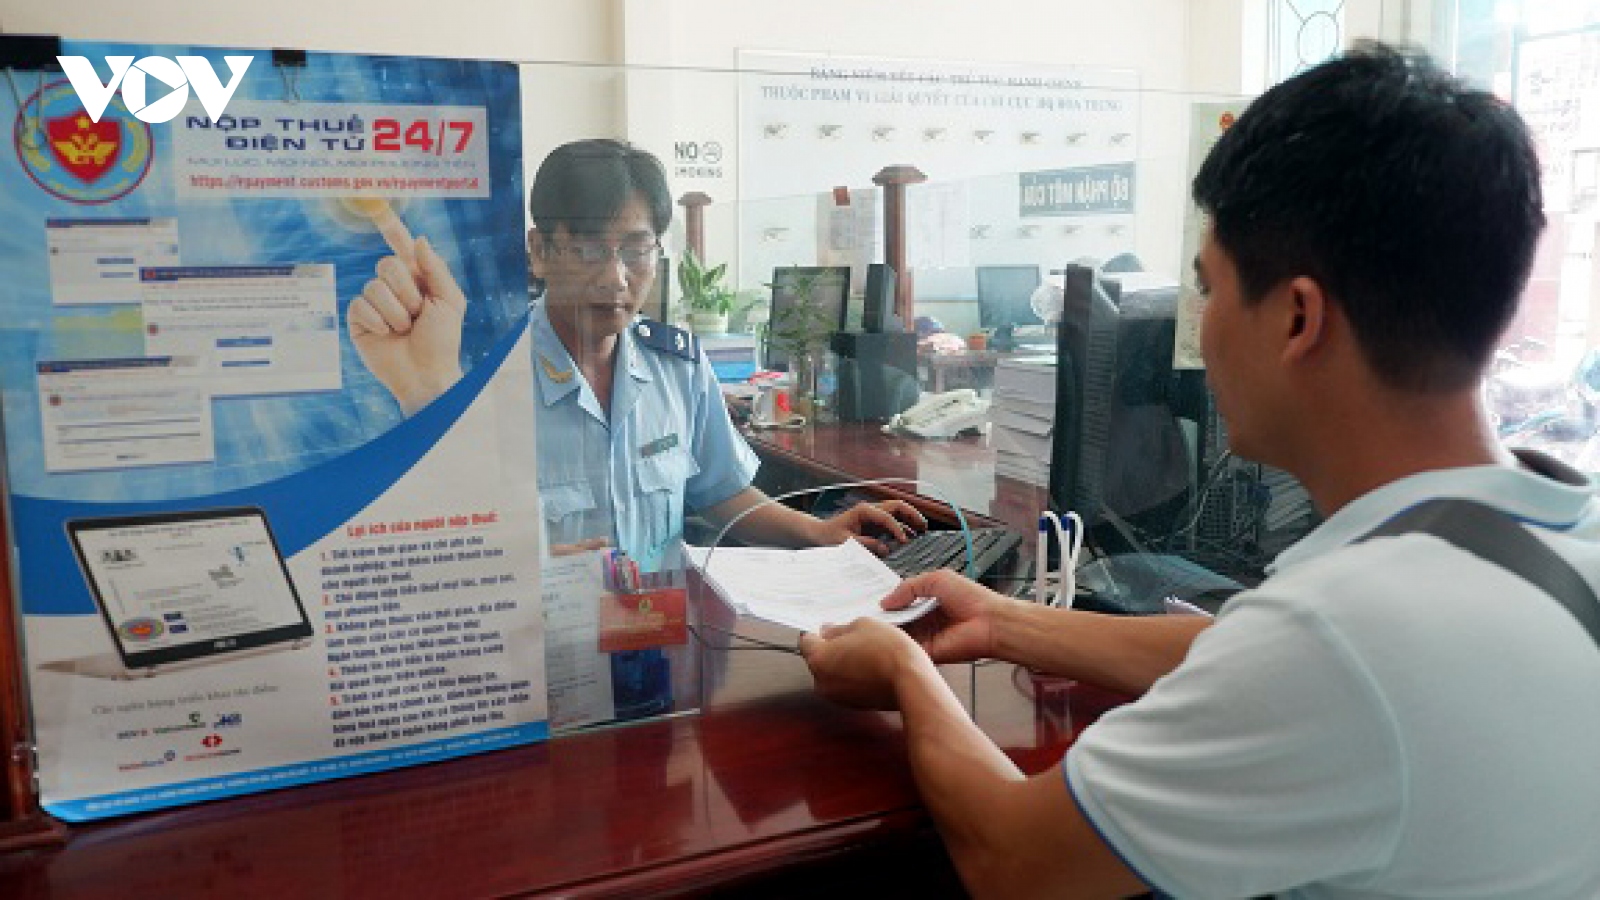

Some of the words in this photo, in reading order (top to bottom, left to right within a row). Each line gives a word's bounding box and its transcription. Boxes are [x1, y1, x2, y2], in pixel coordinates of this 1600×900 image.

[186, 113, 261, 133] NỘP
[225, 133, 306, 152] ĐIỆN
[372, 118, 475, 156] 24/7
[674, 141, 698, 159] NO
